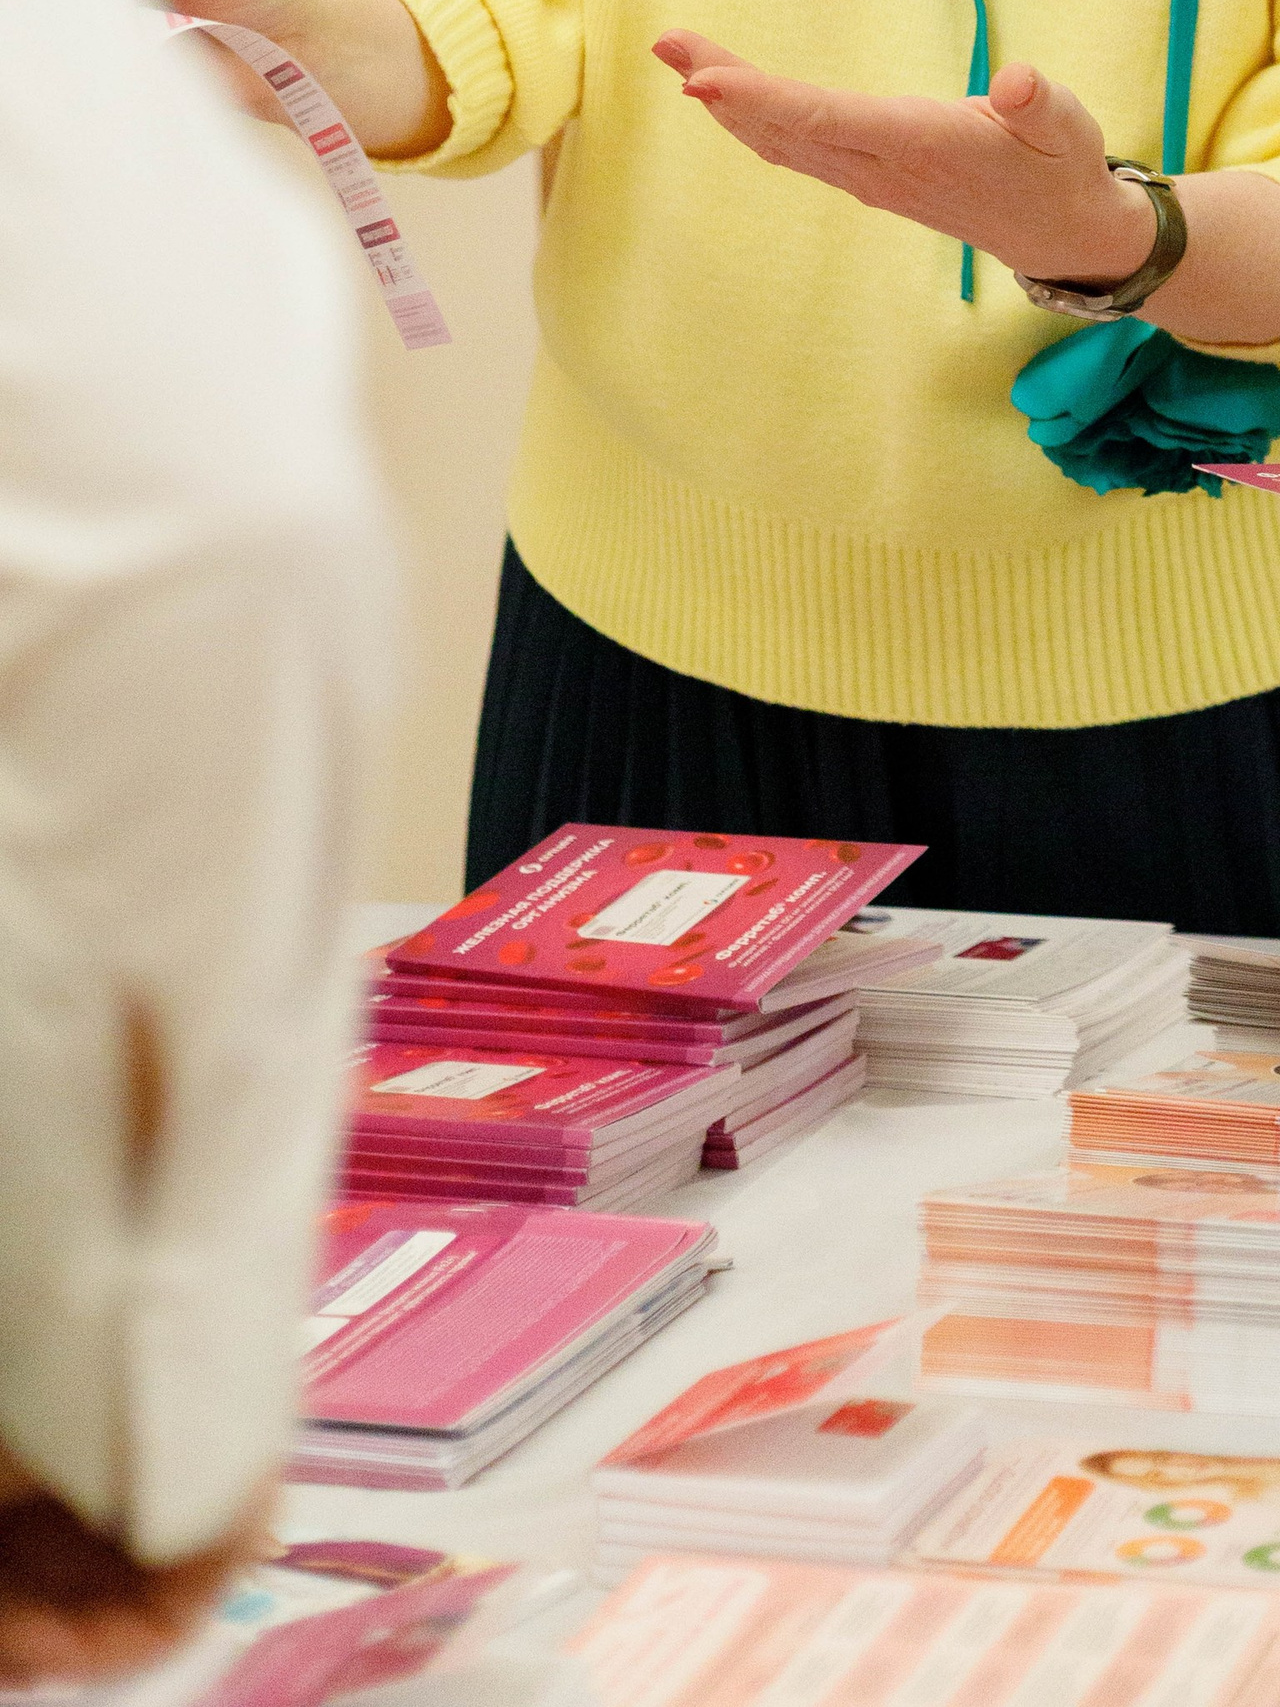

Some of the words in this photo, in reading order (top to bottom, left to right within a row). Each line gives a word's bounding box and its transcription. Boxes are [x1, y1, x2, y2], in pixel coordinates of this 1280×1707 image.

[450, 900, 534, 954] ЖЕЛЕЗНАЯ
[521, 838, 617, 900] ПОДДЕРЖКА
[506, 868, 601, 930] ОРГАНИЗМА
[710, 902, 792, 960] Ферретаб®
[781, 871, 829, 902] комп.
